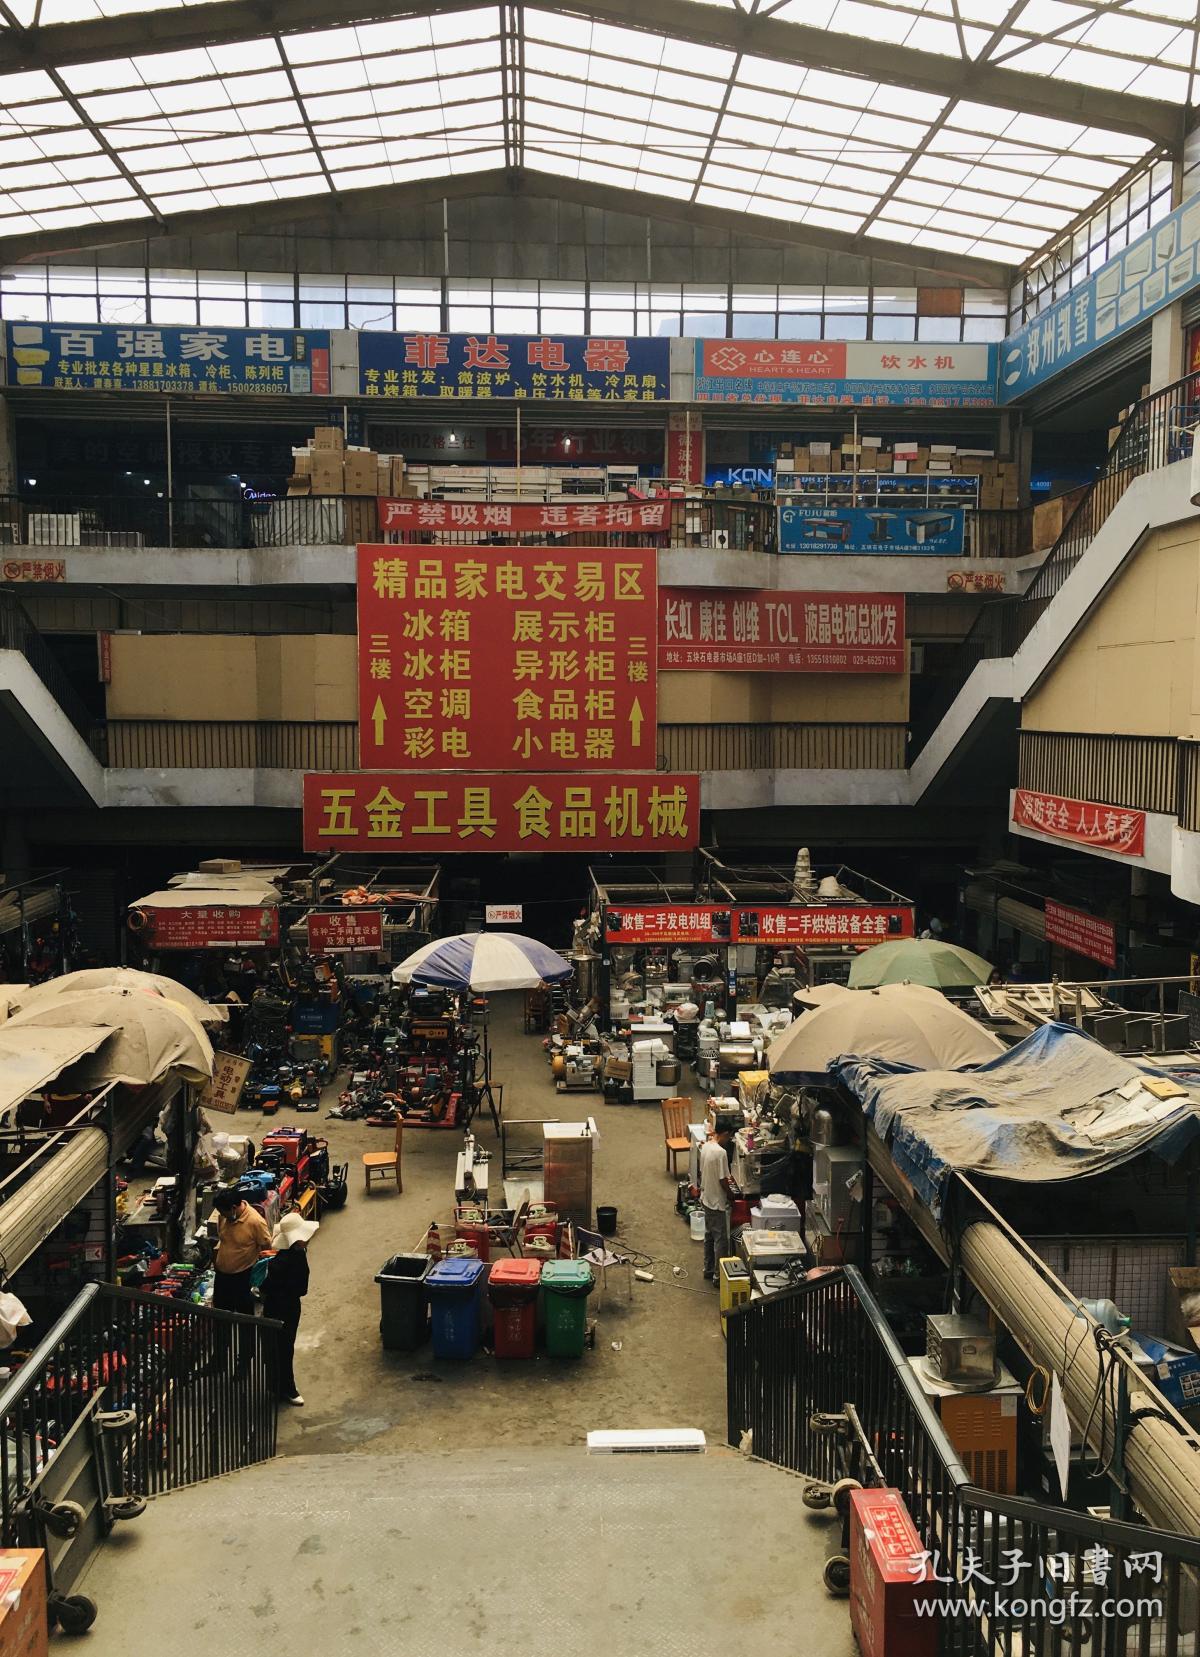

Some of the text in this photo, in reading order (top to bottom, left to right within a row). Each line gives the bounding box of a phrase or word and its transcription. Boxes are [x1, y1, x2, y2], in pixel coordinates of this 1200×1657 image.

[50, 329, 292, 362] 百强家电
[1027, 291, 1090, 377] 郑州凯雪
[403, 335, 629, 372] 菲达电器
[754, 349, 829, 365] 心连心
[881, 354, 955, 371] 饮水机
[750, 366, 786, 374] HEART
[384, 502, 665, 527] 严禁吸烟 违者拘留
[21, 561, 65, 580] 严禁烟火
[372, 557, 645, 602] 精品家电交易区
[964, 575, 1005, 592] 严禁烟火
[402, 608, 471, 642] 冰箱
[512, 610, 616, 643] 展示柜
[665, 599, 897, 645] 长虹 康佳 创维 TCL 液晶电视总批发
[369, 634, 391, 680] 三楼
[402, 649, 472, 681] 冰柜
[512, 649, 616, 682] 异形柜
[627, 636, 649, 682] 三楼
[404, 688, 472, 720] 空调
[512, 687, 616, 721] 食品柜
[403, 727, 472, 760] 彩电
[512, 728, 616, 760] 小电器
[318, 785, 689, 839] 五金工具 食品机械
[1023, 794, 1135, 844] 消防安全 人人有责
[181, 910, 242, 919] 大量收购
[329, 914, 357, 927] 收售
[495, 910, 522, 920] 严禁烟火
[622, 911, 712, 931] 收售二手发电机组
[762, 913, 887, 936] 收售二手烘焙设备全套
[326, 936, 367, 946] 及发电机
